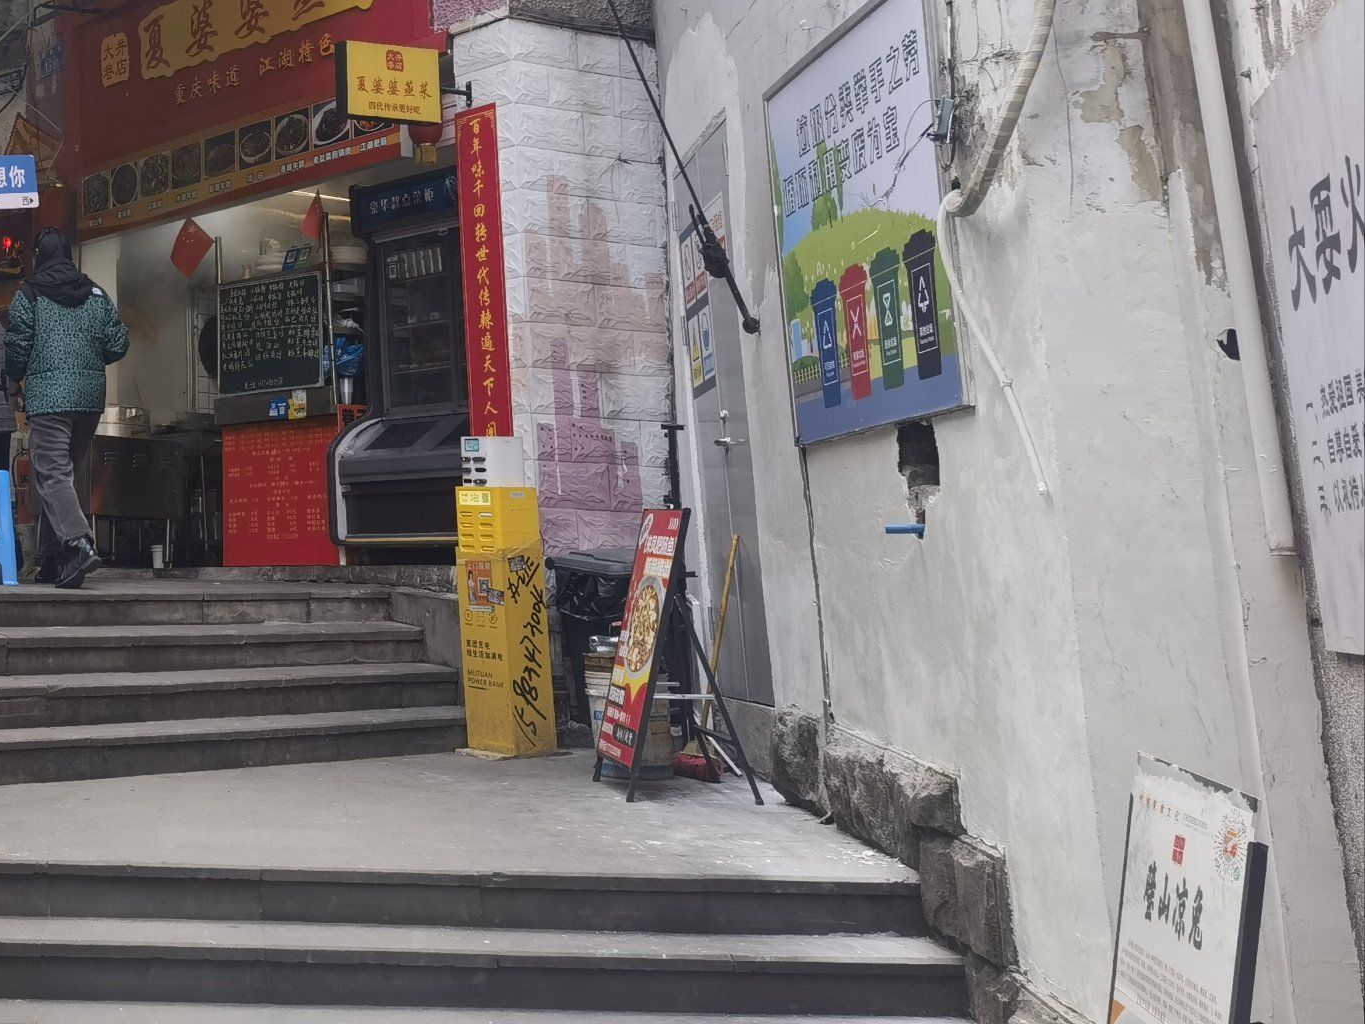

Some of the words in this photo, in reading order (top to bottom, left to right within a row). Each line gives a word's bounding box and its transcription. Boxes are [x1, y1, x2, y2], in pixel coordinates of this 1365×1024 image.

[173, 64, 241, 106] 重庆味道
[259, 32, 336, 76] 江湖特色
[356, 76, 432, 99] 夏婆婆蒸菜
[796, 29, 920, 158] 垃圾分类举手之劳
[368, 101, 422, 115] 四代传承更好吃
[783, 106, 900, 218] 循环利用变废为宝
[22, 196, 30, 206] 西
[467, 669, 493, 678] MEITUAN
[467, 676, 487, 686] POWER
[488, 679, 505, 688] BANK
